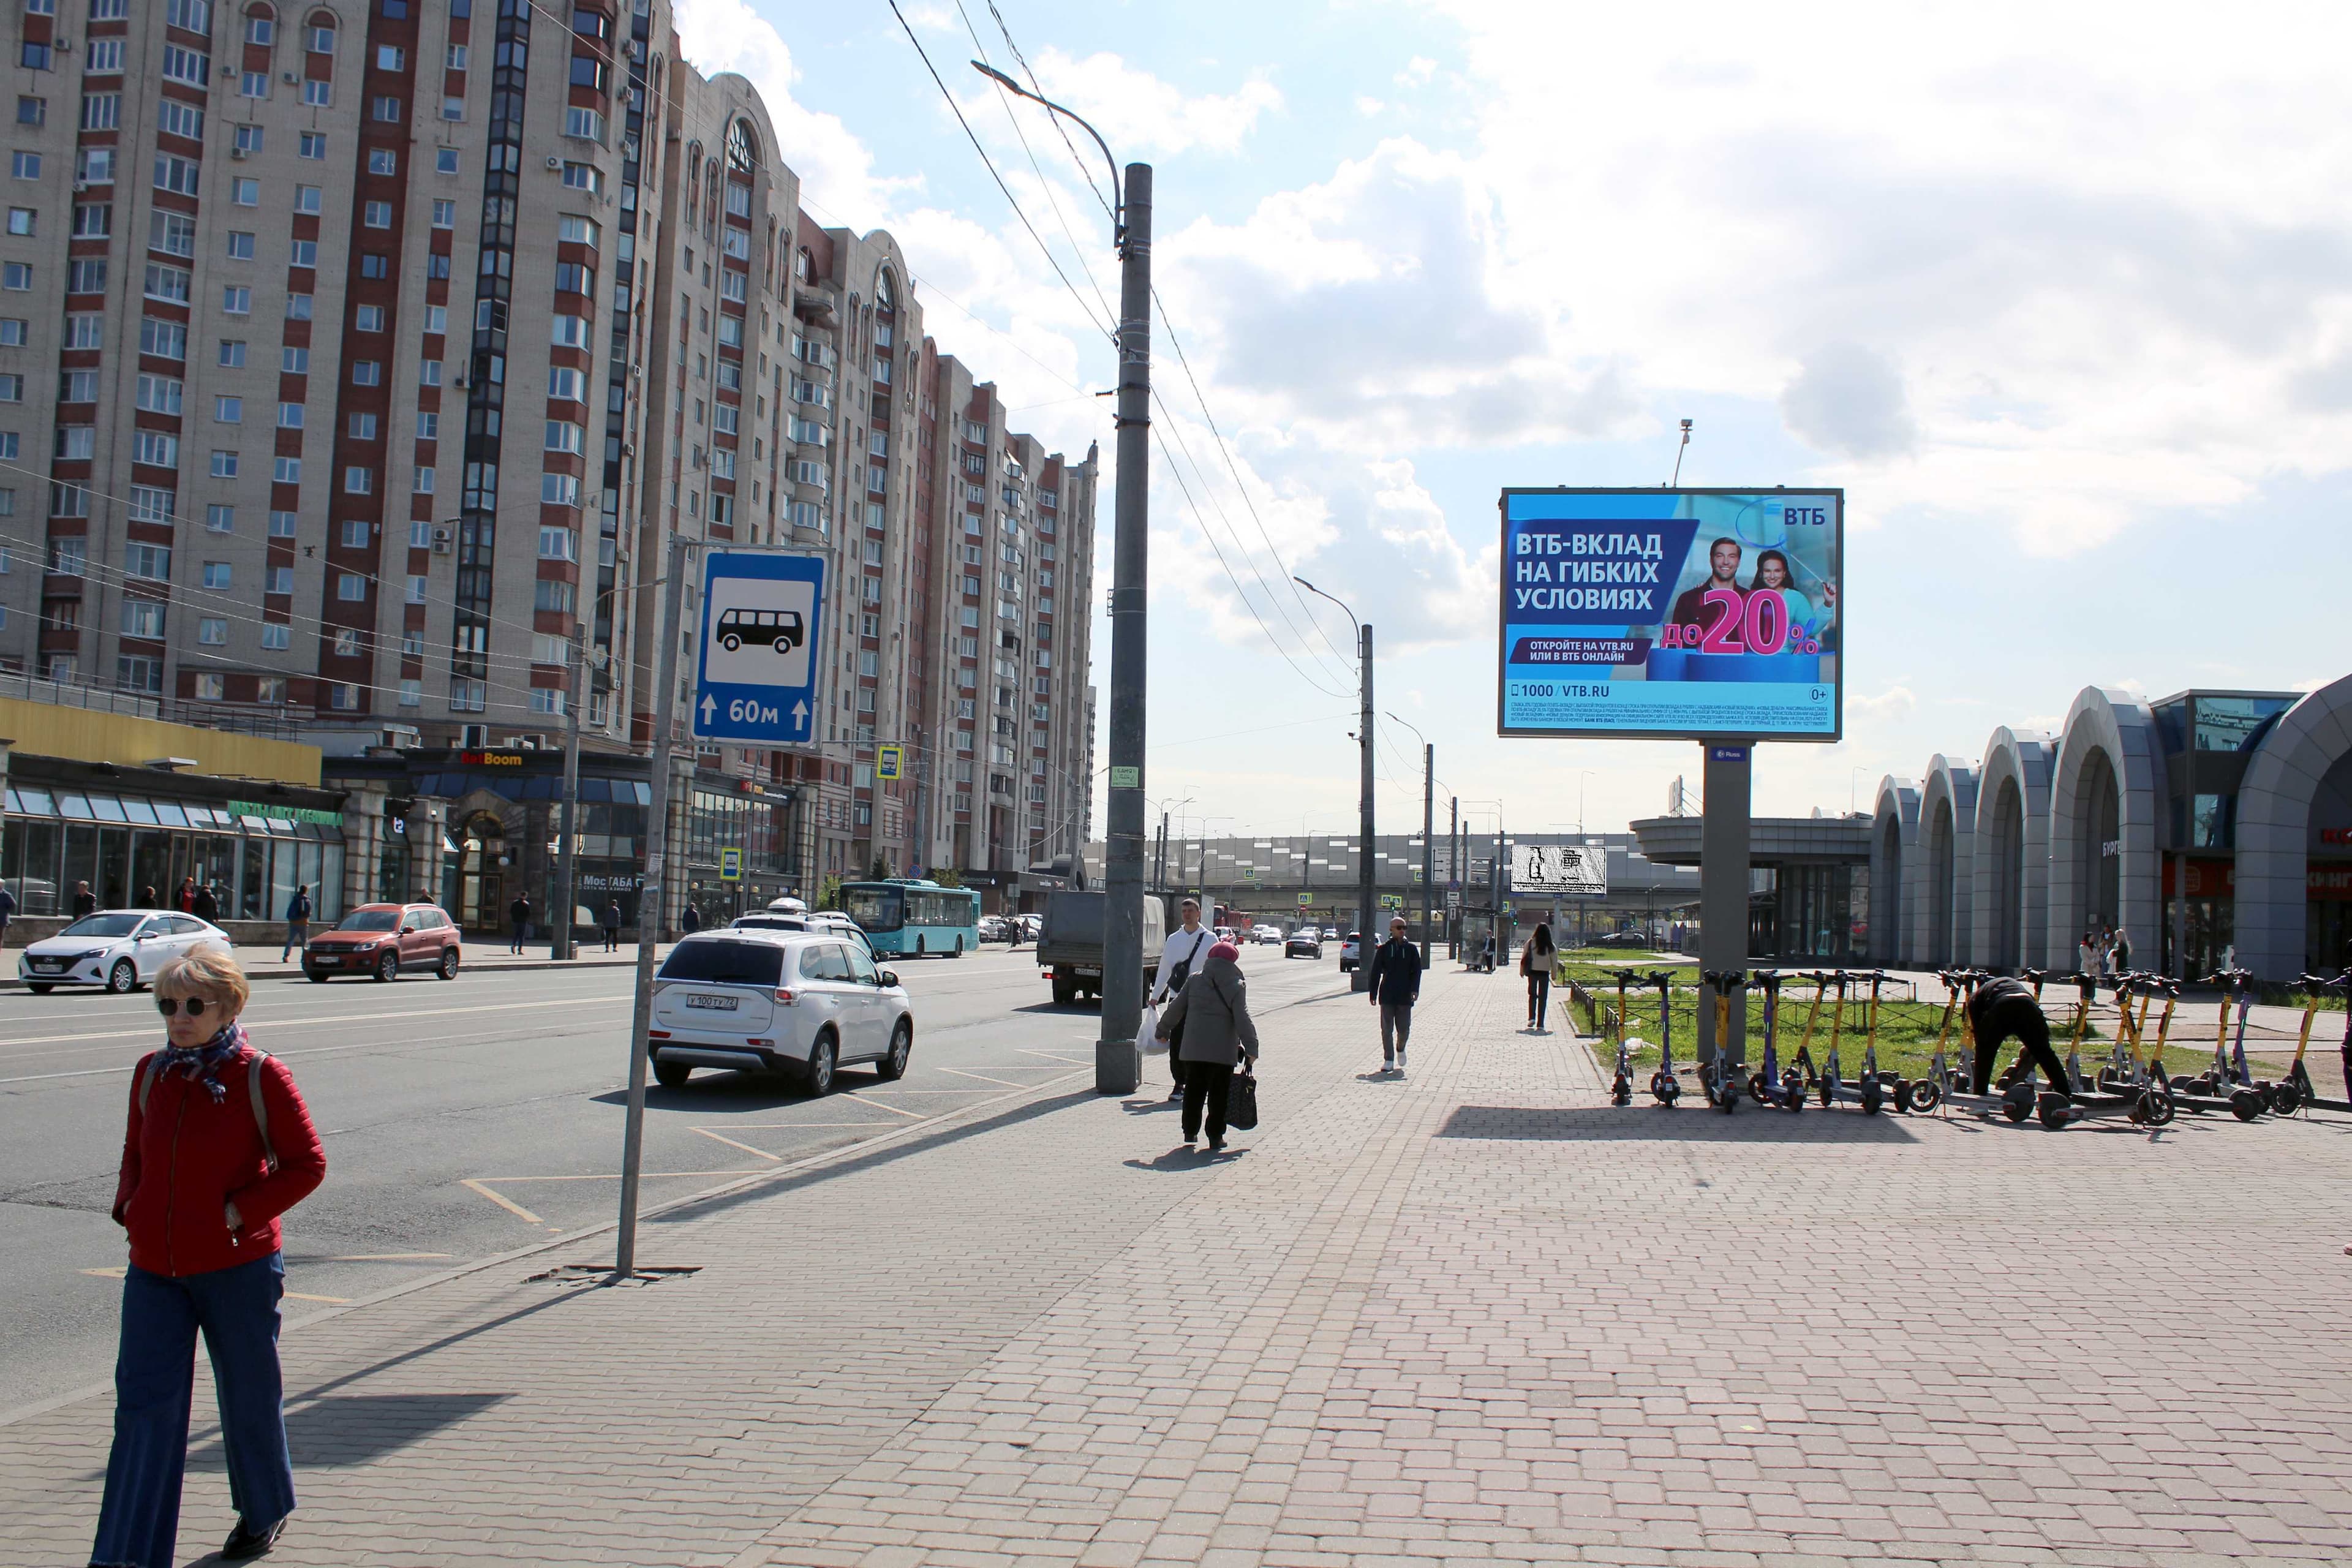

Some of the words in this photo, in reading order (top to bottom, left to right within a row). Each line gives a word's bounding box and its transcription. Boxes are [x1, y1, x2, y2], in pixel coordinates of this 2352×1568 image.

[1784, 508, 1825, 525] ВТБ
[1516, 533, 1662, 559] ВТБ-ВКЛАД
[1517, 562, 1551, 582] НА
[1559, 562, 1659, 583] ГИБКИХ
[1515, 588, 1653, 610] УСЛОВИЯХ
[1530, 639, 1581, 650] ОТКРОЙТЕ
[1583, 642, 1597, 650] НА
[1599, 643, 1634, 651] VTB.RU
[1530, 652, 1551, 661] ИЛИ
[1553, 652, 1560, 661] В
[1562, 652, 1580, 662] ВТБ
[1581, 651, 1624, 662] ОНЛАЙН
[1522, 684, 1553, 696] 1000
[1562, 685, 1610, 697] VTB.RU
[1811, 689, 1826, 700] 0+
[461, 752, 522, 766] BetBoom
[2103, 840, 2120, 857] БУРГЕ
